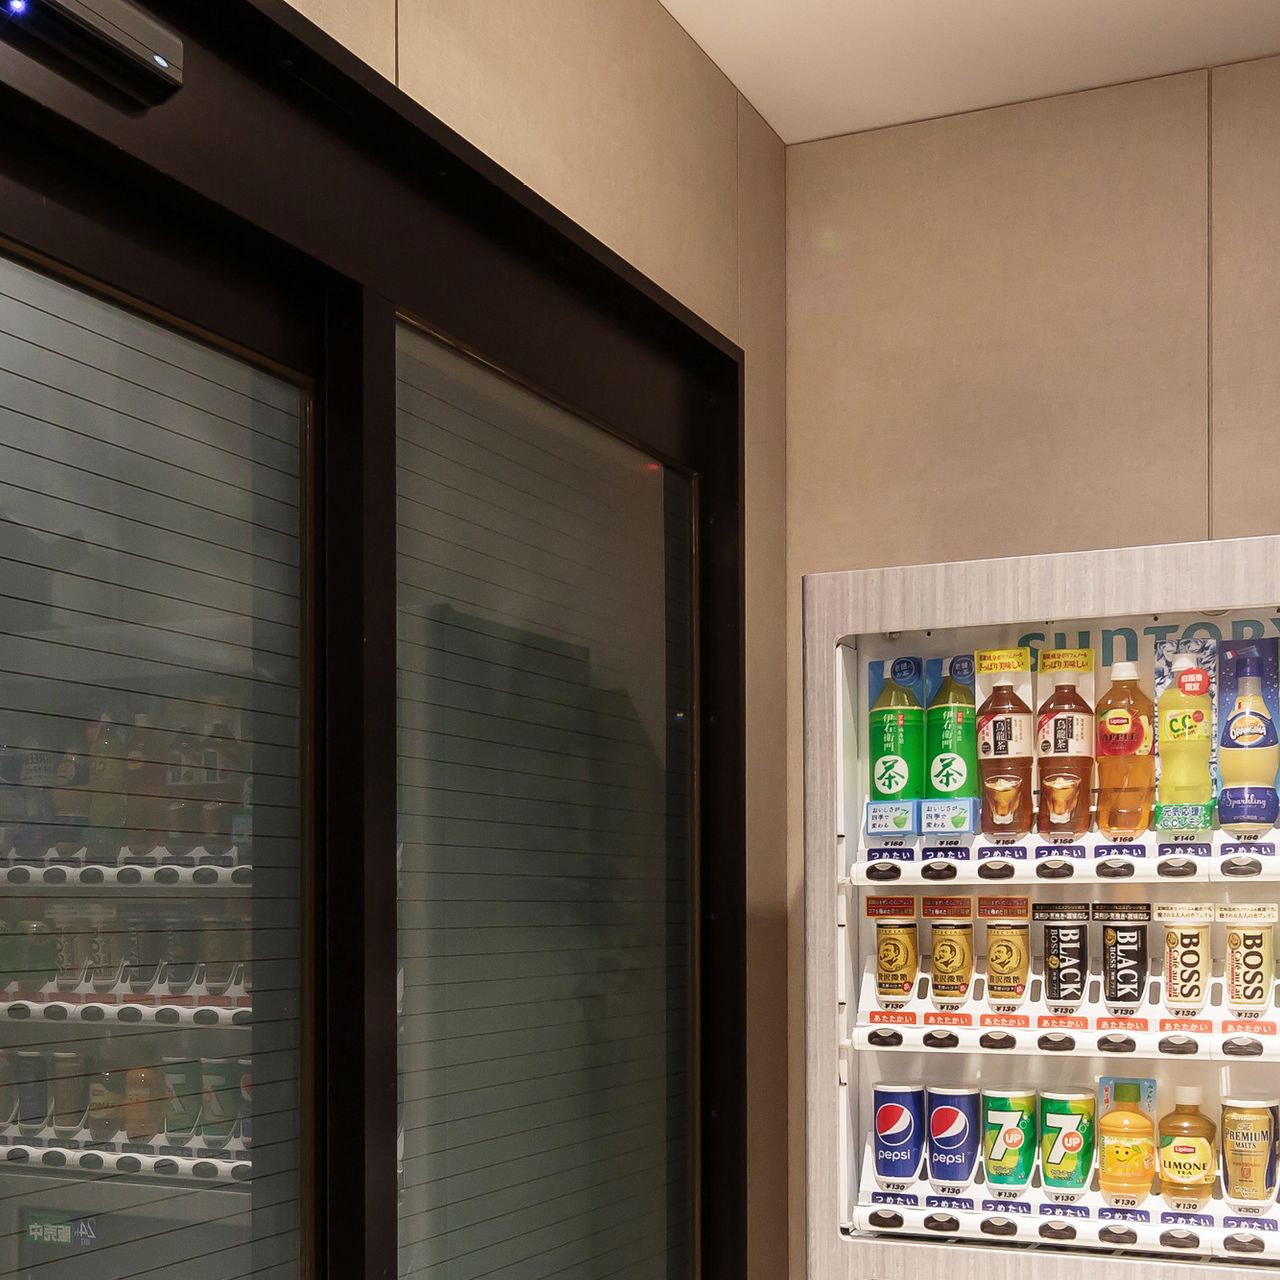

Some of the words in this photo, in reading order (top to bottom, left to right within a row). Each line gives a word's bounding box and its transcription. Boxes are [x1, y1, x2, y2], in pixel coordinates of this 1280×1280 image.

[1102, 732, 1137, 741] APPLE
[877, 759, 905, 790] 茶
[933, 756, 964, 788] 茶
[1226, 790, 1266, 809] Sparkling
[1052, 837, 1074, 845] ¥160
[871, 851, 911, 859] つめたい
[926, 851, 966, 859] つめたい
[980, 848, 1020, 859] つめたい
[1038, 847, 1079, 858] つめたい
[1099, 846, 1140, 857] つめたい
[1163, 848, 1207, 856] つめたい
[1226, 846, 1271, 855] つめたい
[1050, 929, 1058, 955] BOSS
[1059, 928, 1082, 998] BLACK
[1109, 946, 1117, 972] BOSS
[1116, 930, 1139, 998] BLACK
[1180, 932, 1201, 999] BOSS
[1242, 933, 1264, 1000] BOSS
[1173, 972, 1179, 983] au
[1236, 973, 1242, 983] au
[873, 1014, 913, 1023] あたたかい
[928, 1016, 968, 1024] あたたかい
[1237, 1011, 1260, 1019] ¥130
[984, 1017, 1025, 1026] あたたかい
[1041, 1019, 1084, 1028] あたたかい
[1101, 1021, 1144, 1030] あたたかい
[1164, 1022, 1208, 1031] あたたかい
[1226, 1024, 1272, 1033] あたたかい
[987, 1110, 1024, 1162] 7
[1005, 1133, 1022, 1143] UP
[1046, 1112, 1084, 1165] 7
[1225, 1127, 1269, 1142] PREMIUM
[1064, 1136, 1080, 1148] UP
[1235, 1142, 1257, 1150] MALTS
[878, 1149, 911, 1162] pepsi
[932, 1152, 965, 1165] pepsi
[1163, 1160, 1208, 1171] LIMONE
[885, 1183, 906, 1191] ¥130
[940, 1187, 961, 1195] ¥130
[875, 1195, 915, 1205] つめたい
[997, 1191, 1018, 1199] ¥130
[930, 1199, 970, 1209] つめたい
[986, 1203, 1028, 1213] つめたい
[1114, 1199, 1136, 1207] ¥130
[1043, 1207, 1086, 1218] つめたい
[1103, 1211, 1146, 1222] つめたい
[1165, 1216, 1210, 1226] つめたい
[1227, 1220, 1273, 1231] つめたい
